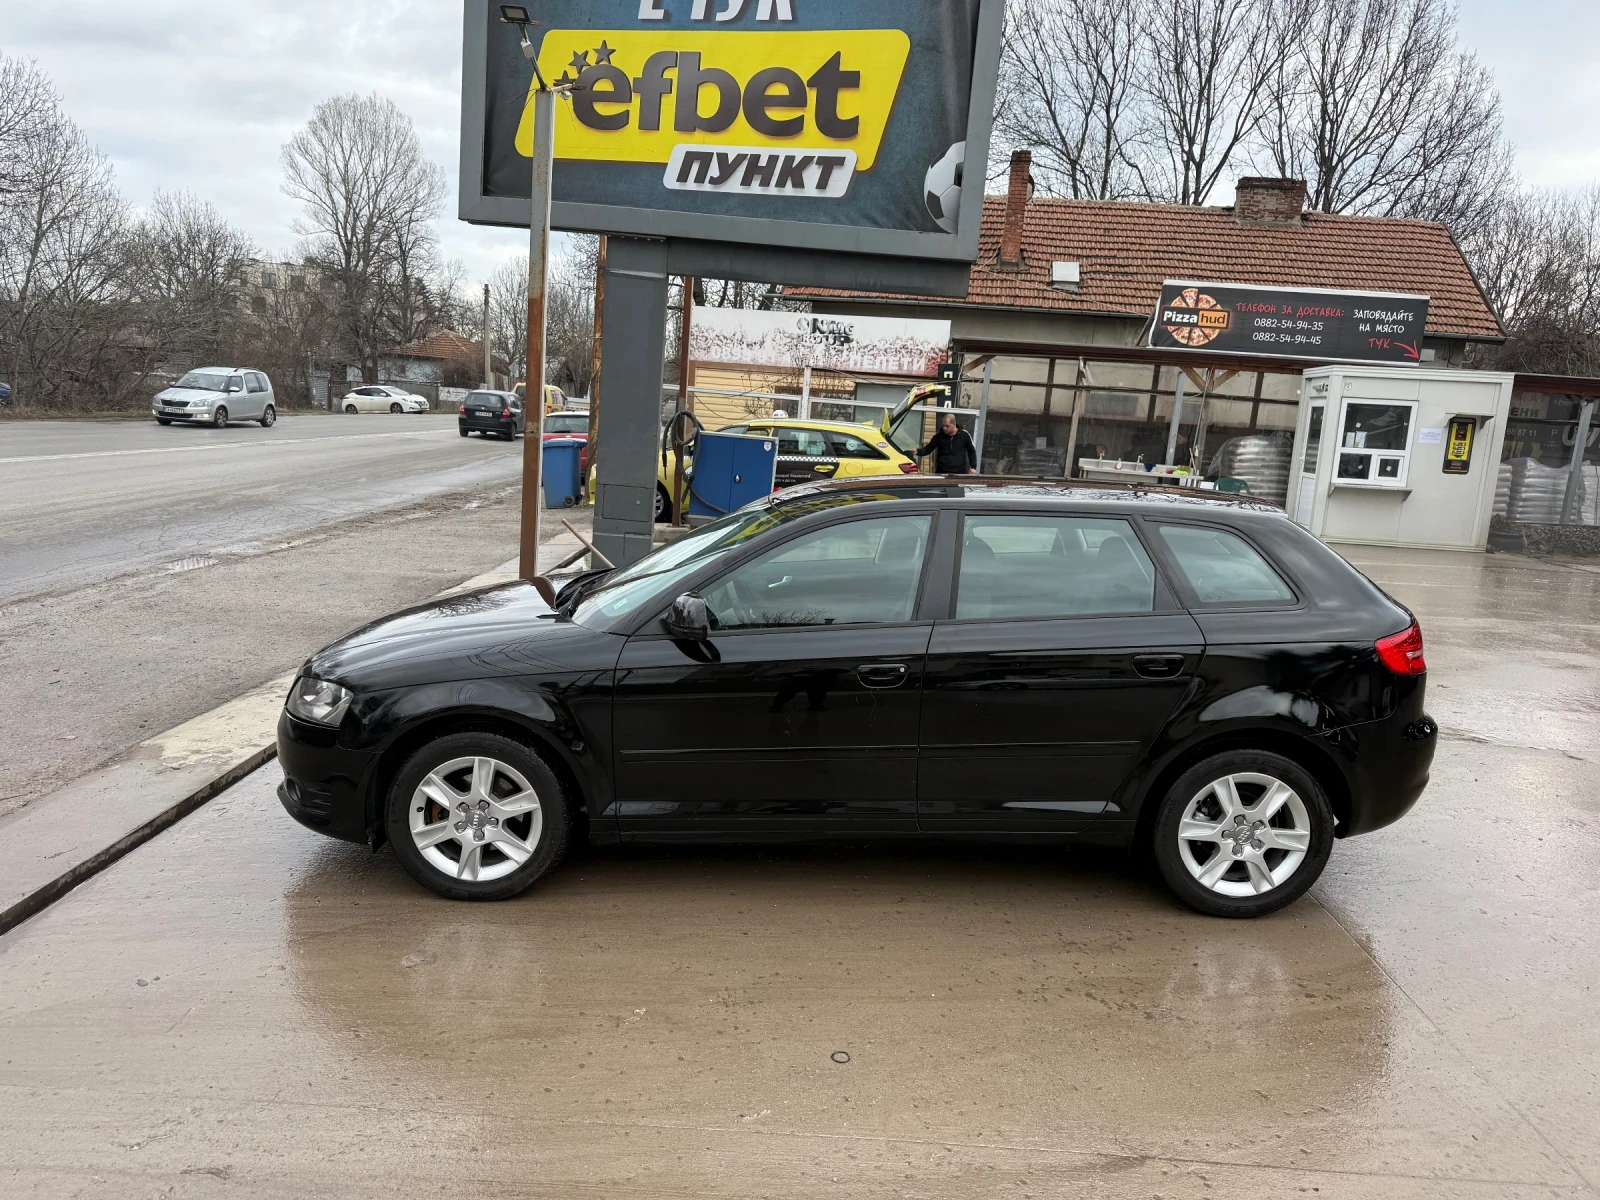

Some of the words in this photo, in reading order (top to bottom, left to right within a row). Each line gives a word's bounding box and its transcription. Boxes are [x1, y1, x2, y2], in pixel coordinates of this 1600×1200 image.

[572, 51, 861, 139] efbet
[676, 150, 847, 190] ПУНКТ
[1236, 303, 1276, 315] ТЕЛЕФОН
[1282, 305, 1294, 314] ЗА
[1297, 305, 1345, 318] ДОСТАВКА:
[1353, 308, 1414, 322] ЗАПОВЯДАЙТЕ
[1163, 311, 1197, 324] Pizza
[1200, 313, 1226, 325] hud
[1254, 318, 1323, 331] 0882-54-94-35
[1359, 323, 1370, 333] НА
[1375, 323, 1405, 334] МЯСТО
[1252, 332, 1322, 345] 0882-54-94-45
[1368, 337, 1391, 349] ТУК
[850, 354, 925, 372] ПЕЛЕТИ
